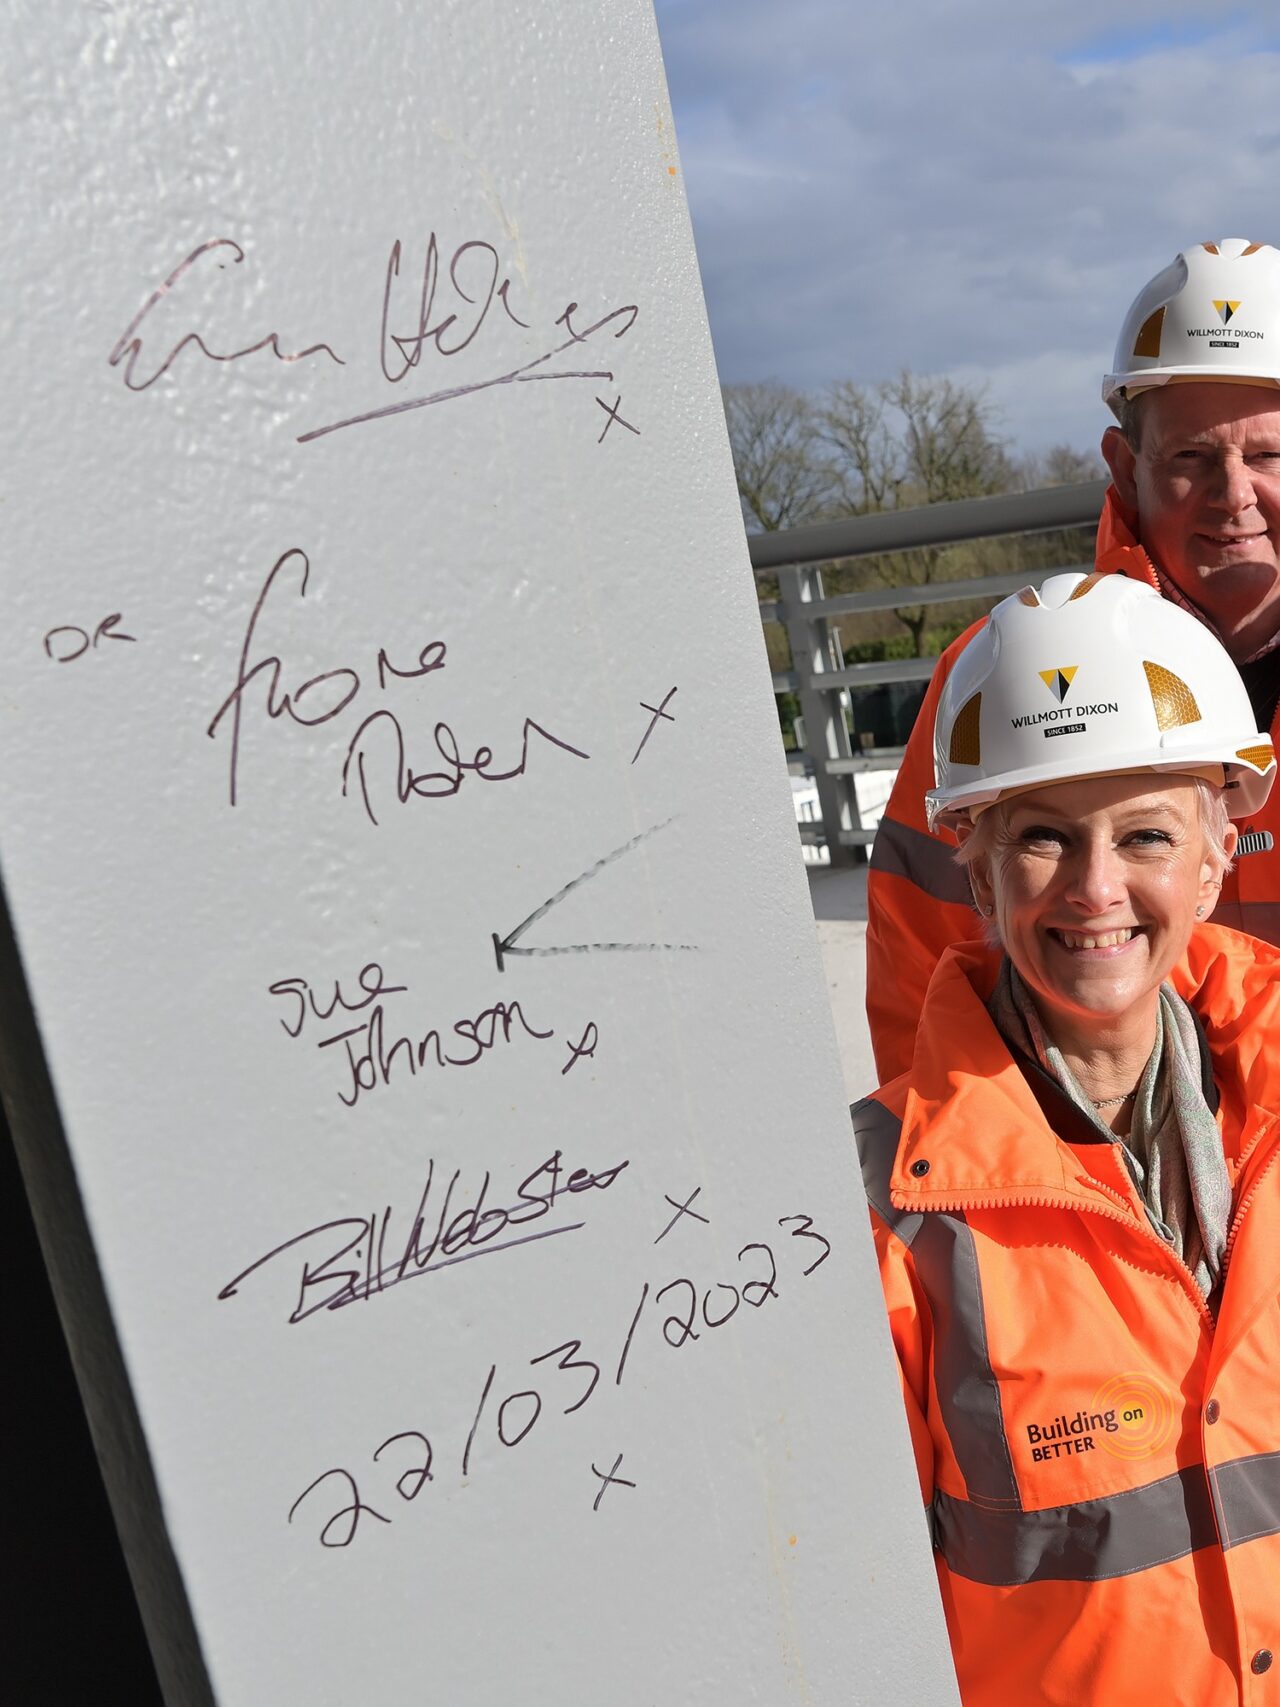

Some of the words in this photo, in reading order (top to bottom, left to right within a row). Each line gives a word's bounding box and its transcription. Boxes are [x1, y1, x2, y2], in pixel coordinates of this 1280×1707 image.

[1186, 328, 1233, 337] WILLMOTT
[1234, 329, 1264, 339] DIXON
[1011, 707, 1073, 729] WILLMOTT
[1076, 702, 1119, 717] DIXON
[1046, 727, 1066, 737] SINCE
[1067, 724, 1084, 733] 1852
[318, 1000, 554, 1107] Johnson
[1026, 1409, 1119, 1445] Building
[1122, 1407, 1144, 1422] on
[1031, 1436, 1096, 1463] BETTER
